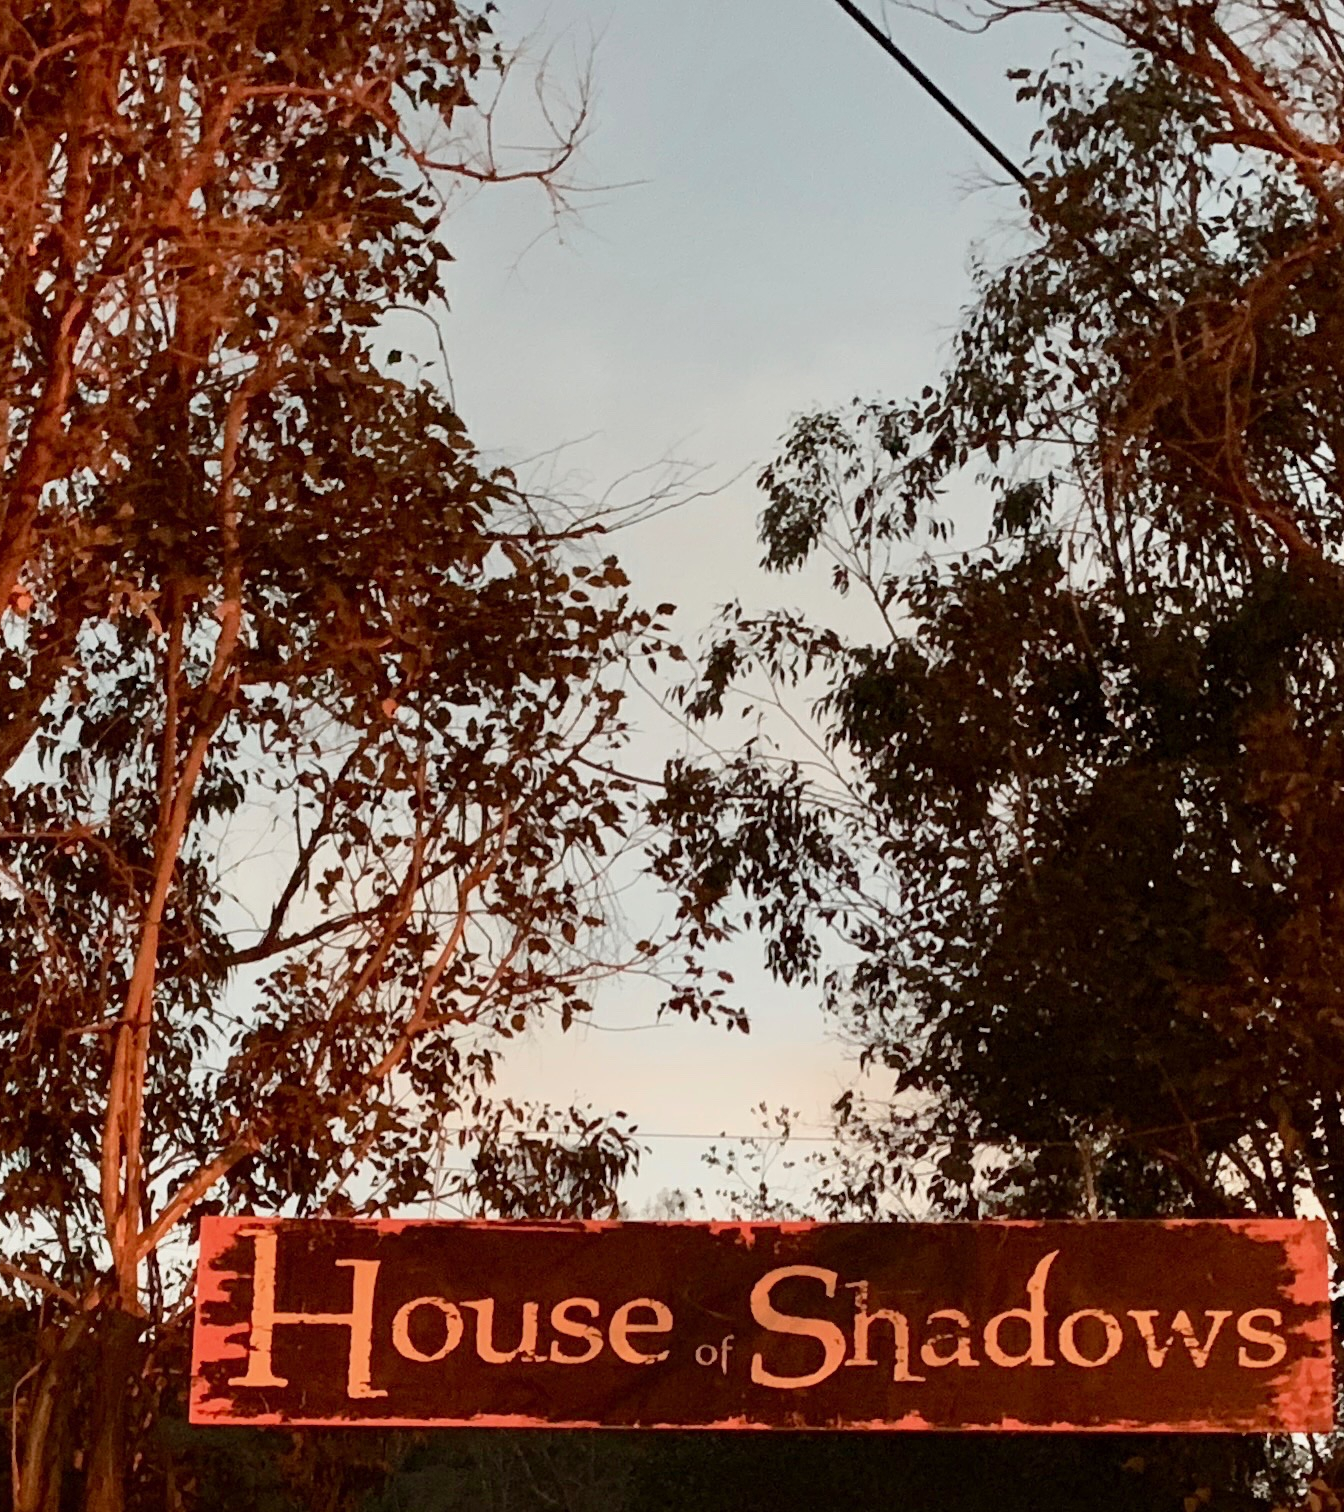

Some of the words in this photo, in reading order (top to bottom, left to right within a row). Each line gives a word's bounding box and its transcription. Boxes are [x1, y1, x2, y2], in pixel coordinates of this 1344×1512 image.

[227, 1224, 674, 1399] House
[694, 1333, 735, 1375] of
[749, 1249, 1288, 1390] Shadows
